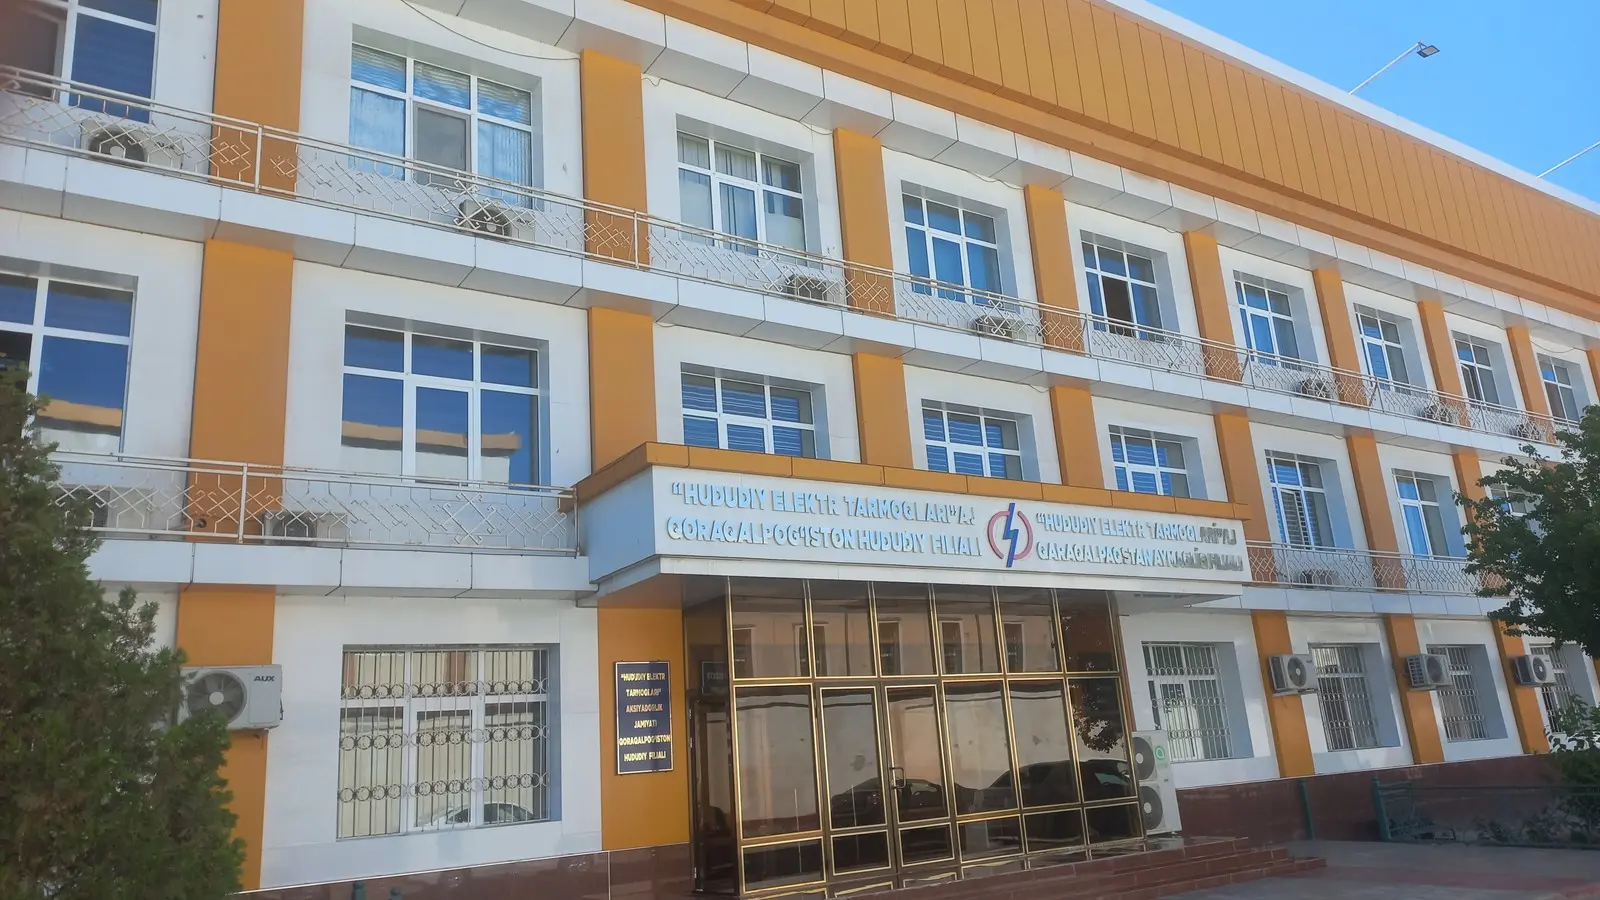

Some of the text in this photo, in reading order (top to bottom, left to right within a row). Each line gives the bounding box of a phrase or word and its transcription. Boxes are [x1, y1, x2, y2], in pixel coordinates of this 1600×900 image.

[771, 489, 840, 516] ELEKTR
[1099, 517, 1145, 539] ELEKTR
[857, 528, 925, 553] HUDUDIY
[931, 534, 983, 557] FILIALI
[647, 672, 665, 680] ELEKTR
[624, 752, 647, 761] HUDUDIY
